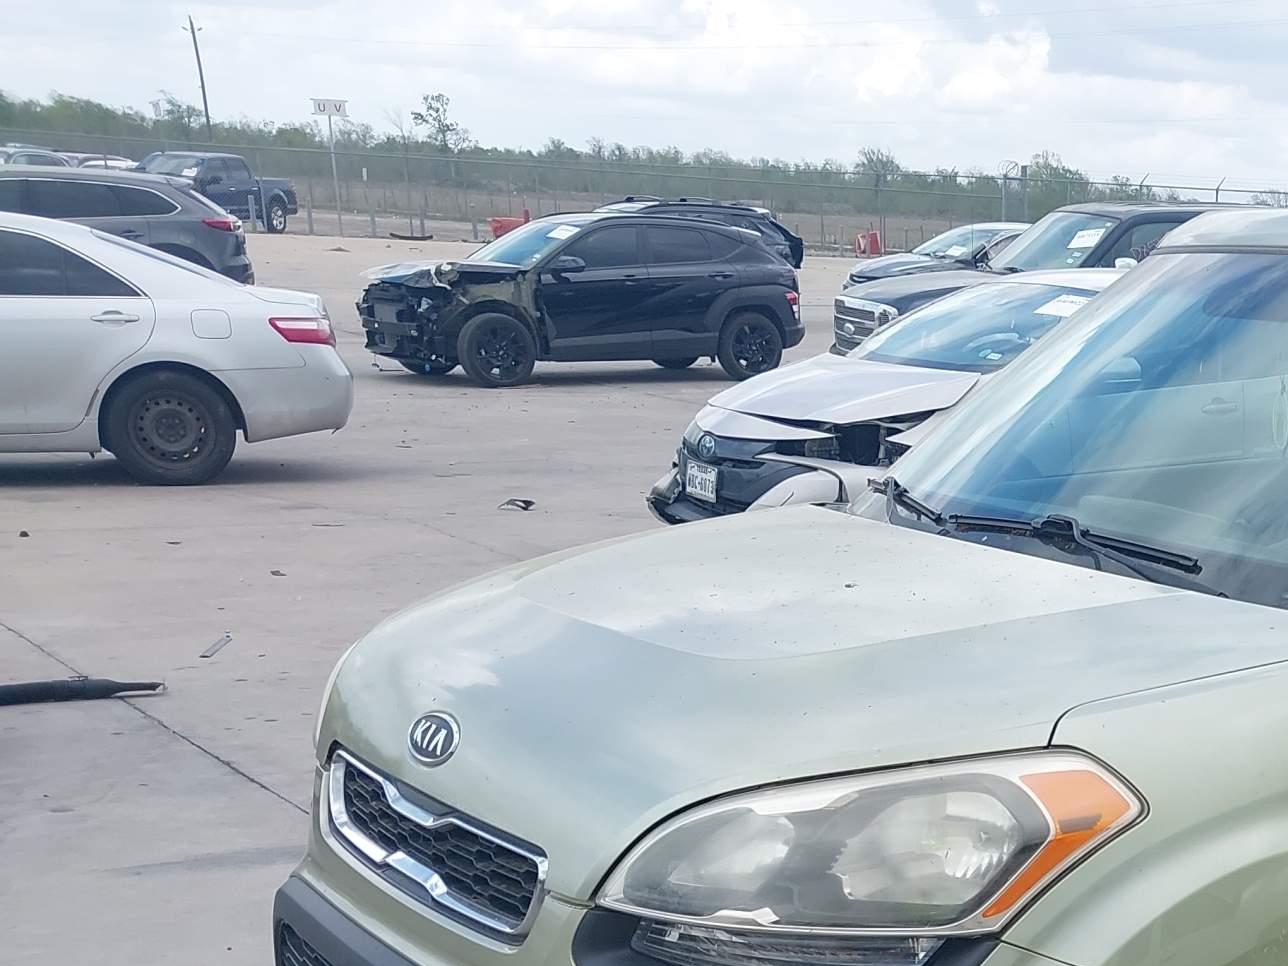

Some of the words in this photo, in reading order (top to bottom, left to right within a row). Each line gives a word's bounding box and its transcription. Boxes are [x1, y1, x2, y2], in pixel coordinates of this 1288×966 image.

[317, 103, 326, 113] U
[334, 103, 342, 113] V
[413, 718, 448, 757] KIA
